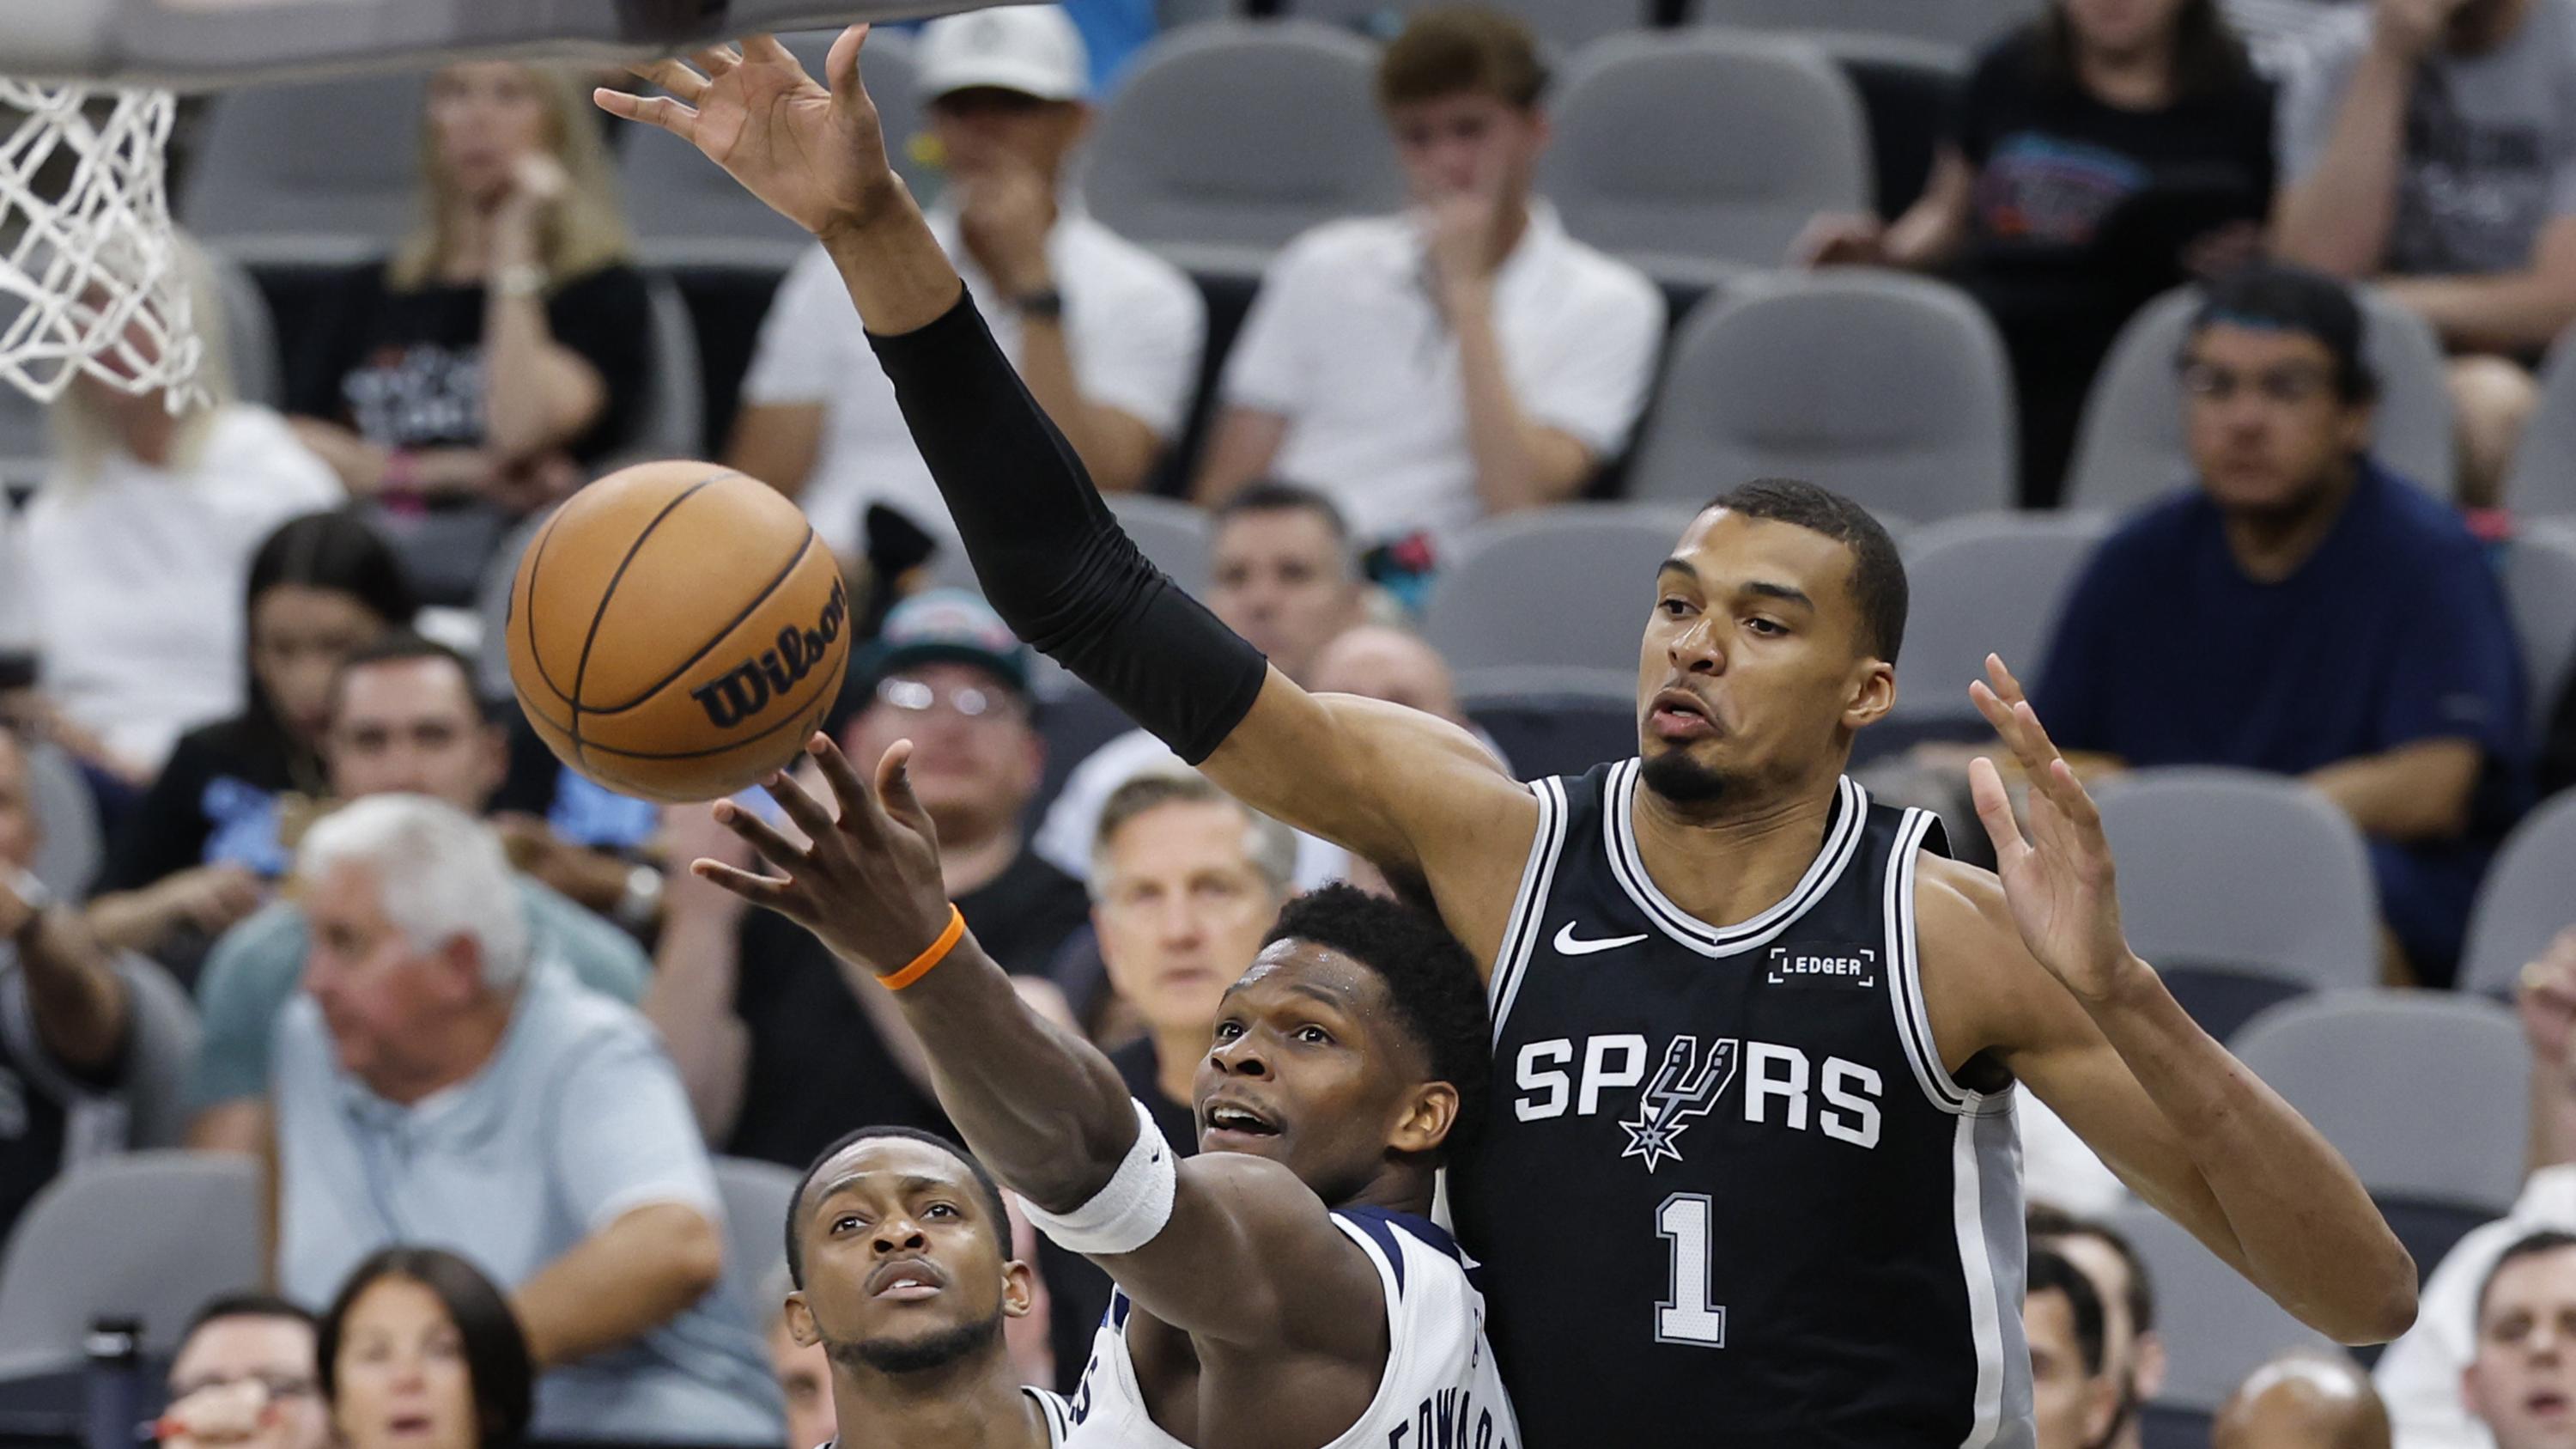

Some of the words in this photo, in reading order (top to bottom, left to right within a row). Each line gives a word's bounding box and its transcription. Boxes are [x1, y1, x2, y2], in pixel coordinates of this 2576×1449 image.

[690, 576, 846, 728] Wilson
[1783, 957, 1862, 976] LEDGER
[1515, 1034, 1882, 1173] SPURS
[1655, 1192, 1726, 1349] 1
